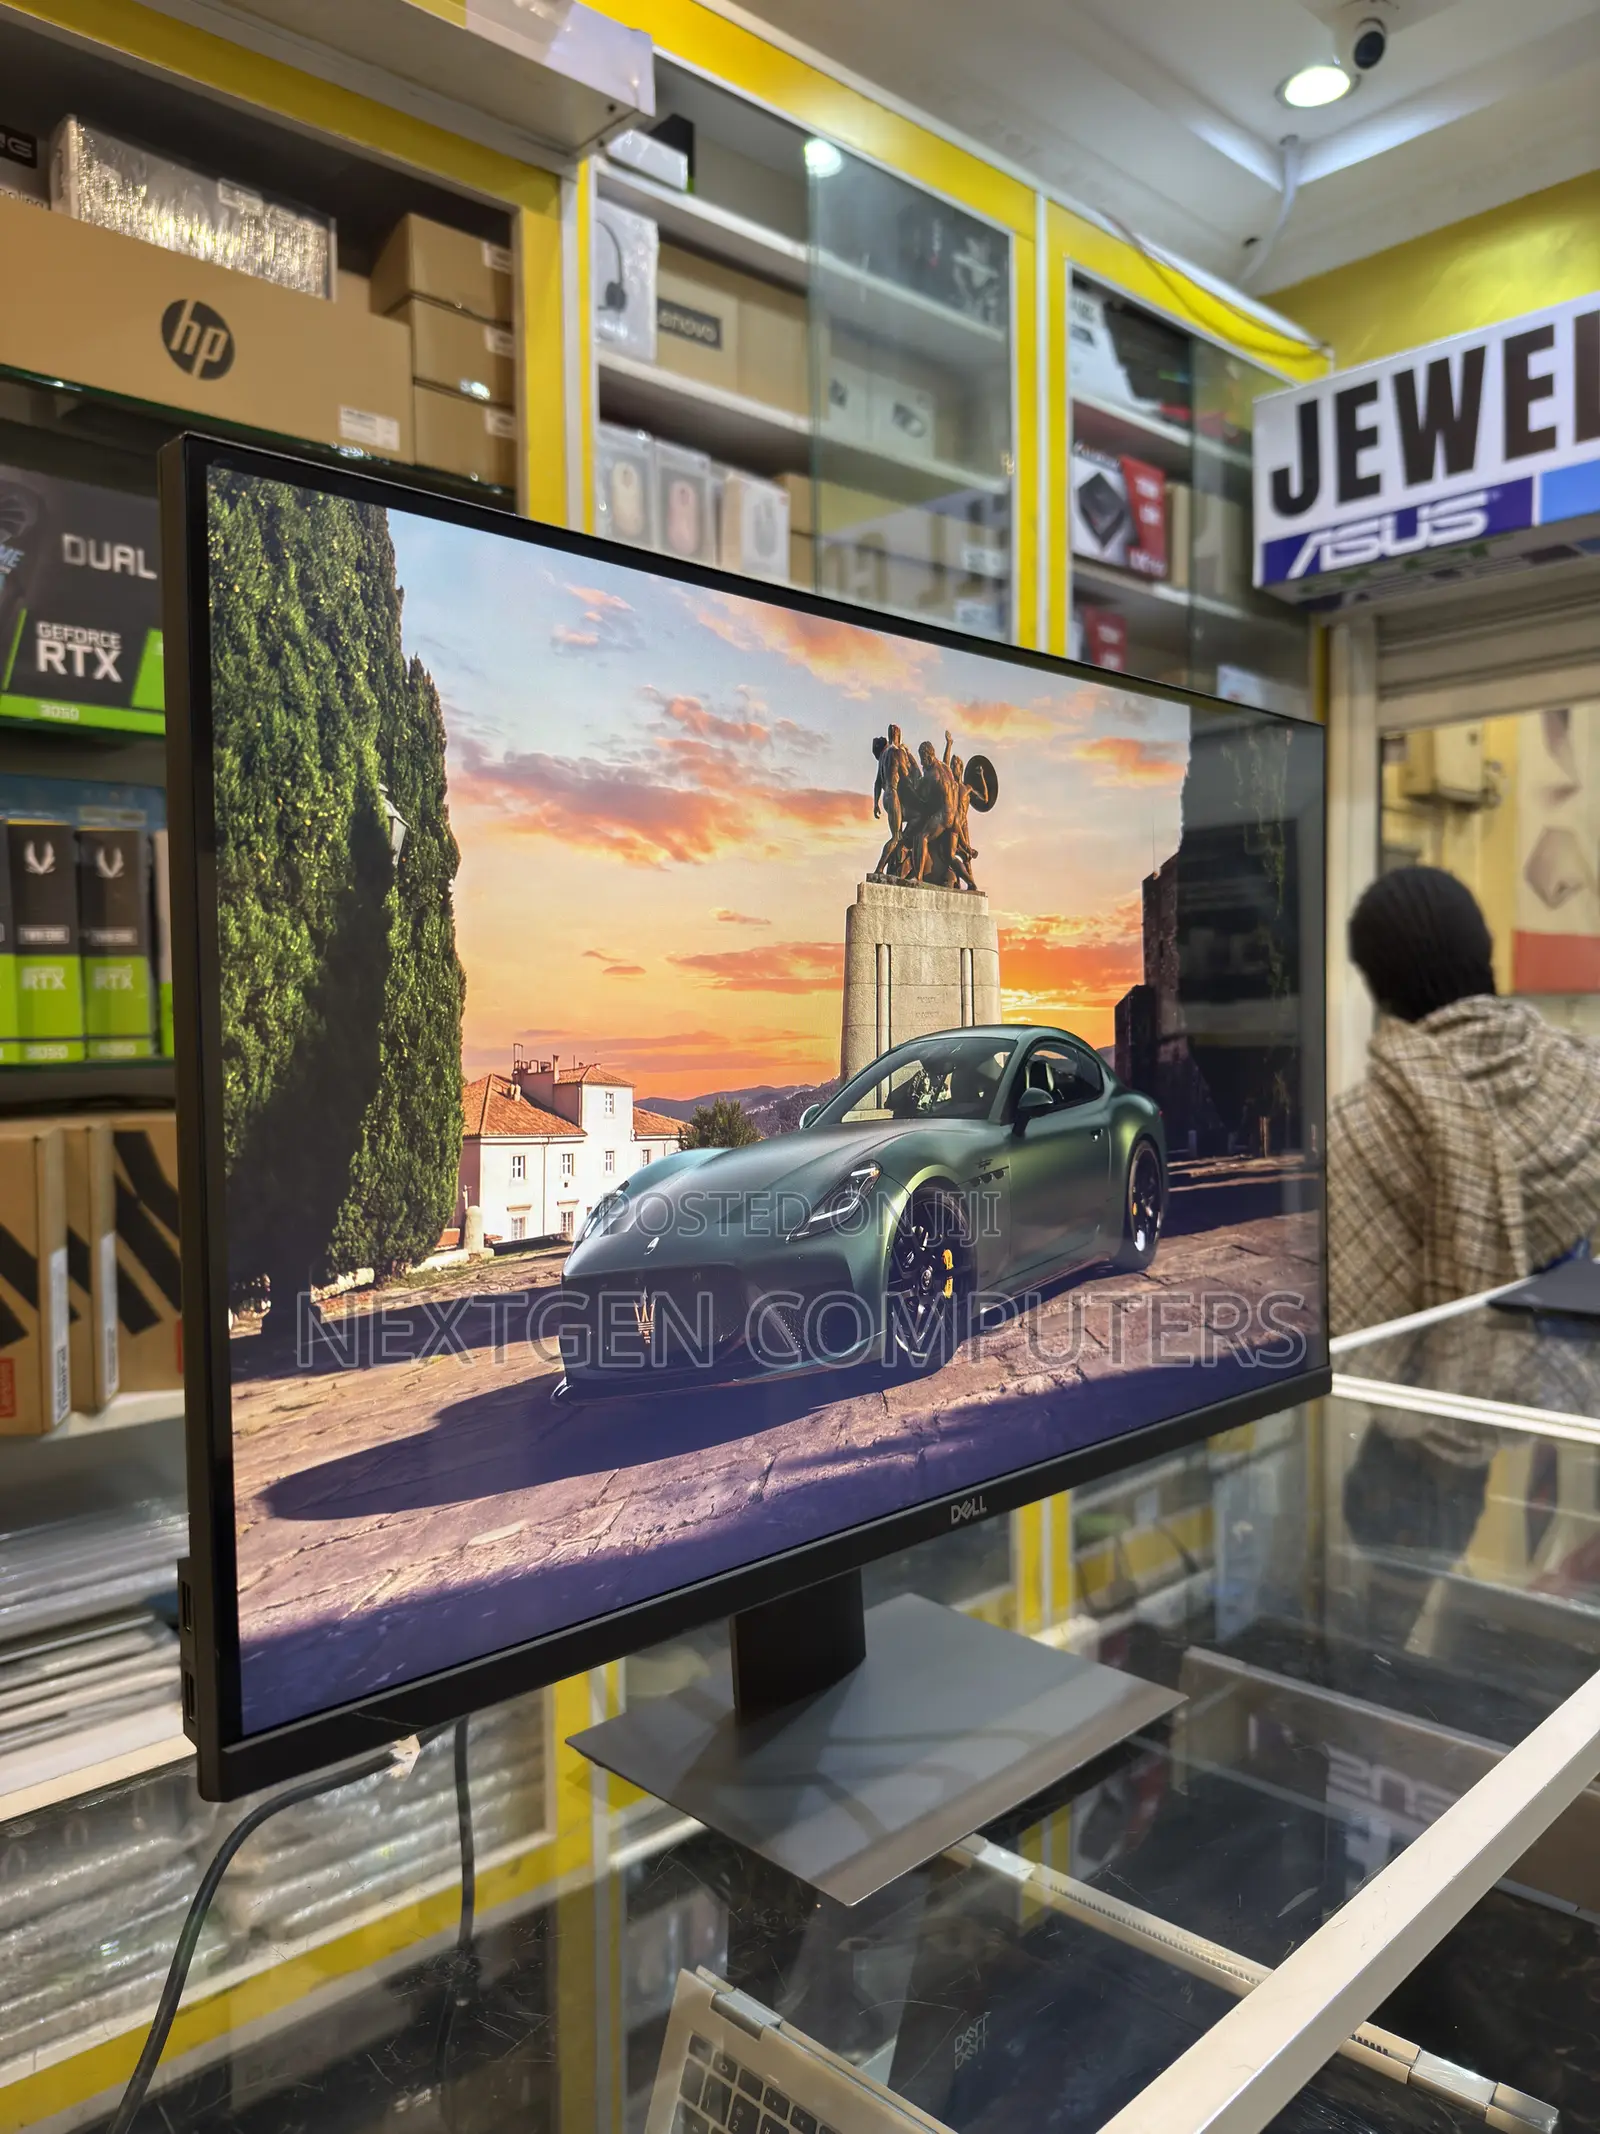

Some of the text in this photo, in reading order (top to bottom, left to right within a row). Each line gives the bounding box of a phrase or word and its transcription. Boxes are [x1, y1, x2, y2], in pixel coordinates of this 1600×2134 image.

[169, 299, 229, 379] hp
[657, 308, 718, 342] enovo
[62, 532, 157, 580] DUAL
[1286, 489, 1488, 580] ASUS
[36, 619, 122, 650] GEFORCE
[36, 638, 123, 684] RTX
[951, 1495, 988, 1525] DELL
